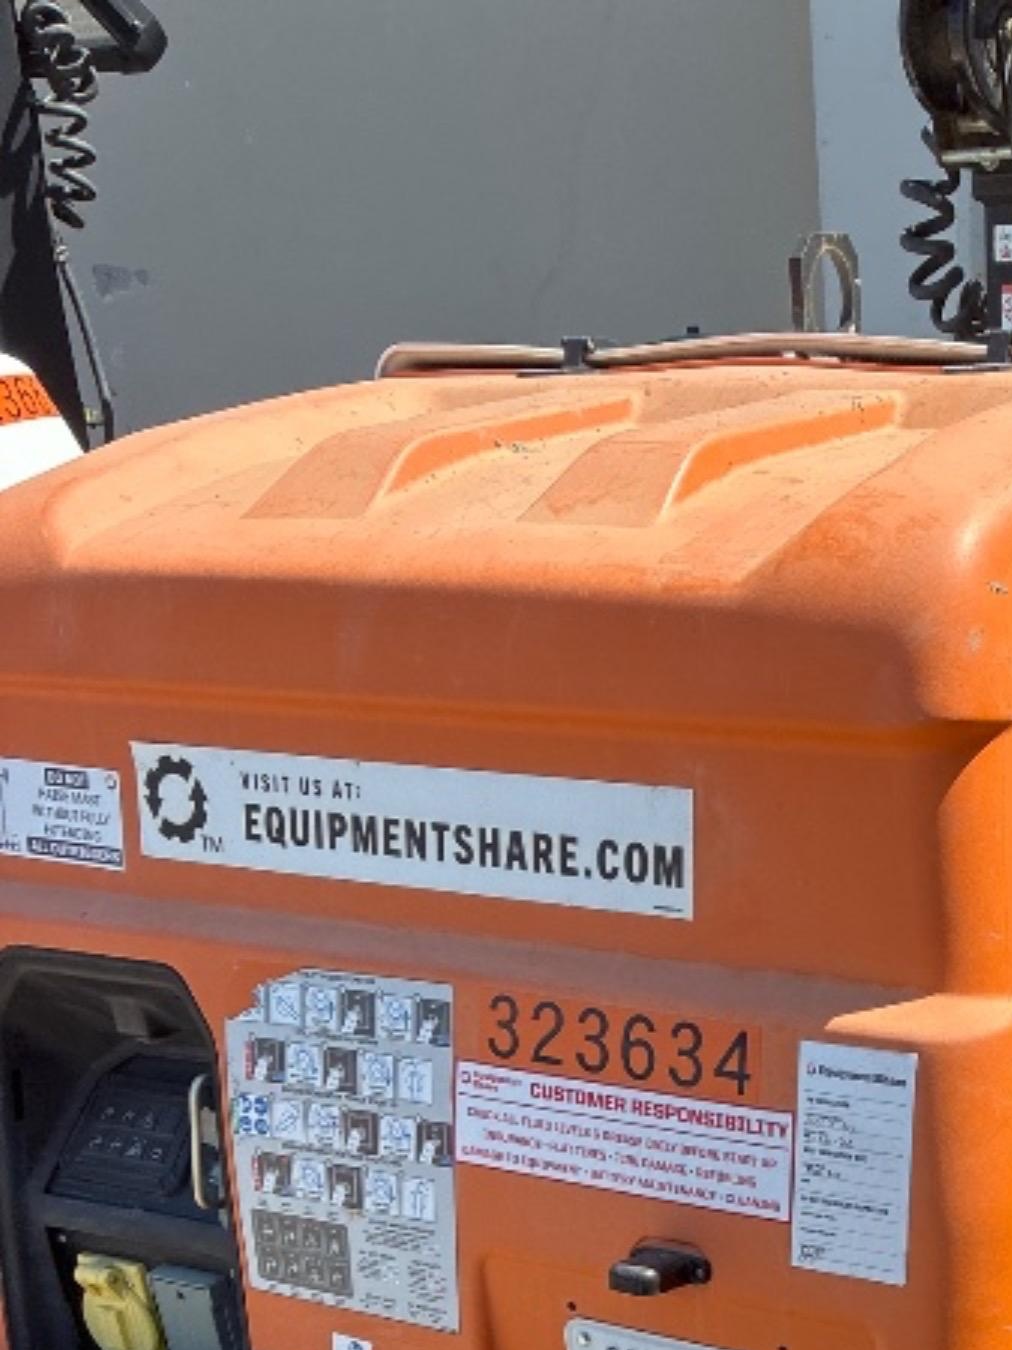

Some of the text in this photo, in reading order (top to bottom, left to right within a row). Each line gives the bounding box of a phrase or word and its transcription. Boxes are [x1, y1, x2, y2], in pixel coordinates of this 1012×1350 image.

[240, 771, 360, 800] VISIT US AT:
[201, 834, 225, 852] TM
[244, 803, 686, 889] EQUIPMENTSHARE.COM
[488, 994, 751, 1096] 323634
[530, 1082, 626, 1113] CUSTOMER
[632, 1100, 789, 1138] RESPONSIBILITY
